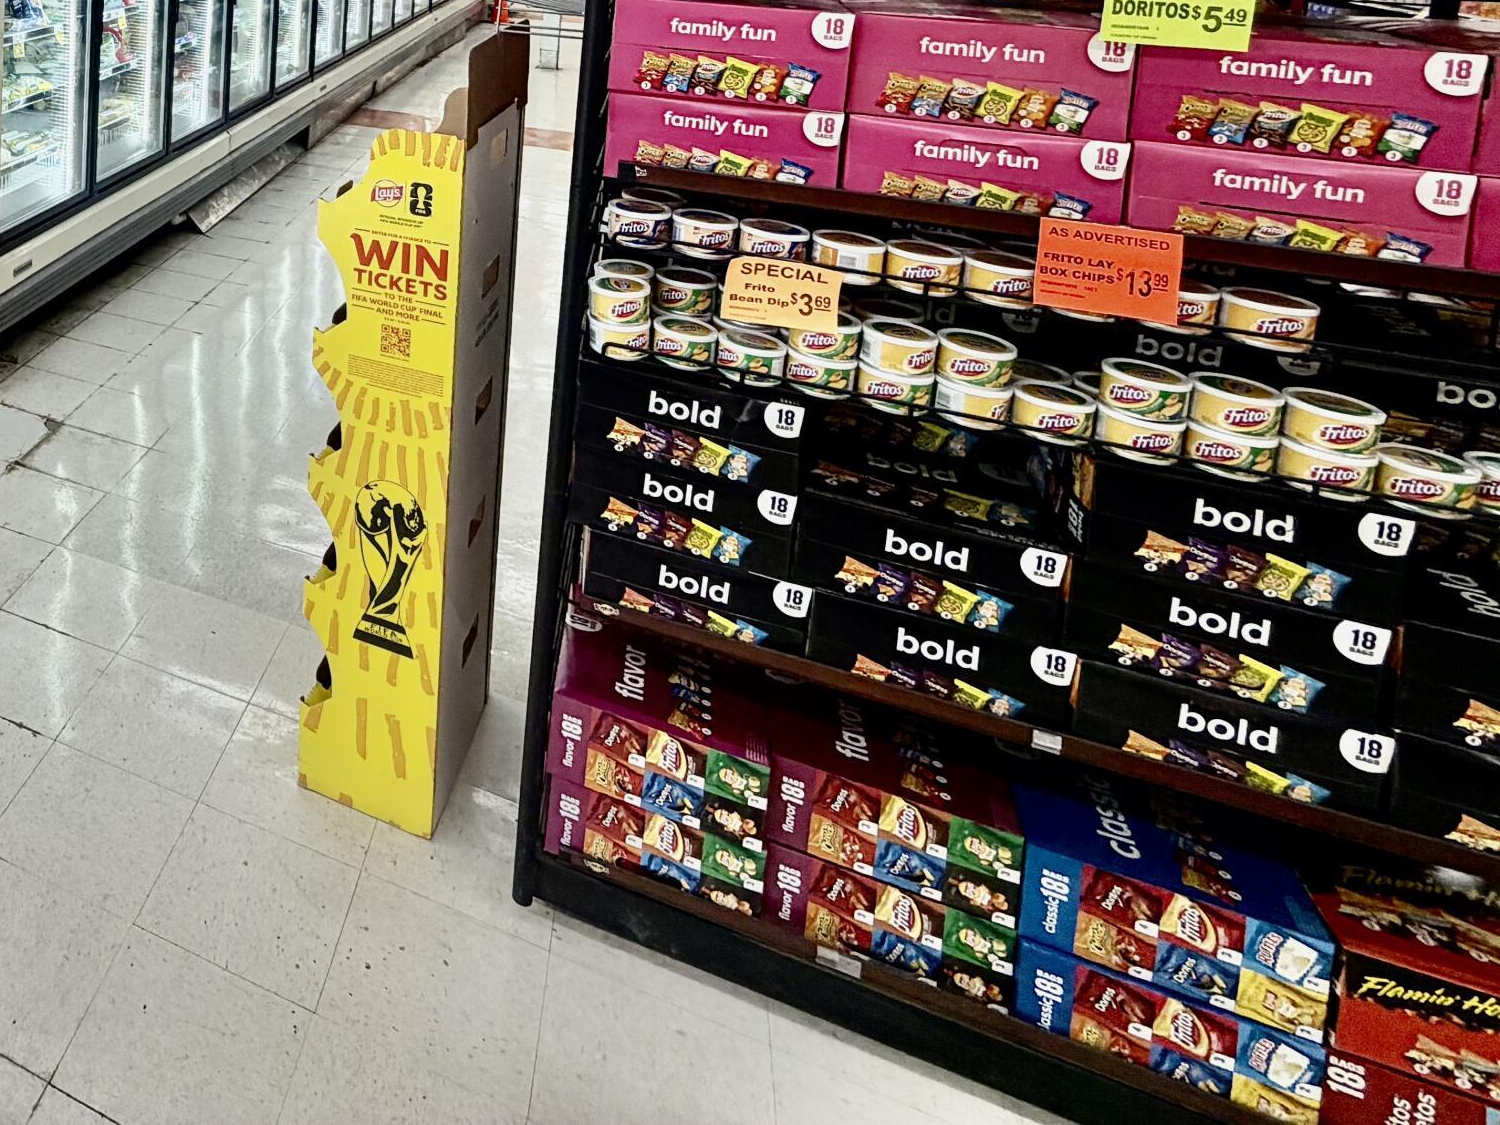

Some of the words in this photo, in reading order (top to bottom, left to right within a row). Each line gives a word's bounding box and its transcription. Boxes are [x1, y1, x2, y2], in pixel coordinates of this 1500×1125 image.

[1111, 0, 1190, 20] DORITOS
[670, 17, 736, 41] family
[740, 21, 777, 43] fun
[824, 18, 845, 36] 18
[919, 36, 998, 62] family
[1002, 42, 1046, 64] fun
[1103, 42, 1127, 57] 18
[1219, 56, 1318, 85] family
[1320, 63, 1374, 87] fun
[1444, 58, 1473, 79] 18
[662, 110, 728, 136] family
[731, 116, 769, 138] fun
[815, 117, 836, 134] 18
[913, 139, 992, 168] family
[996, 146, 1040, 171] fun
[1096, 146, 1119, 166] 18
[375, 185, 401, 202] Lay's
[1212, 168, 1310, 201] family
[1313, 178, 1366, 203] fun
[1434, 178, 1462, 198] 18
[620, 221, 650, 235] Fritos
[1049, 226, 1069, 238] AS
[1073, 230, 1170, 251] ADVERTISED
[350, 232, 449, 283] WIN
[1043, 252, 1084, 266] FRITO
[1087, 258, 1115, 270] LAY
[740, 261, 829, 284] SPECIAL
[904, 265, 941, 279] Fritos
[1039, 265, 1068, 277] BOX
[1072, 270, 1115, 285] CHIPS
[353, 267, 448, 301] TICKETS
[744, 282, 776, 294] Frito
[351, 293, 368, 303] FIFA
[369, 298, 399, 308] WORLD
[400, 303, 417, 313] CUP
[419, 307, 443, 319] FINAL
[384, 292, 396, 300] TO
[398, 294, 413, 304] THE
[729, 293, 763, 306] Bean
[766, 297, 790, 310] Dip
[376, 307, 395, 317] AND
[395, 311, 420, 322] MORE
[802, 332, 837, 348] Fritos
[1135, 332, 1223, 369] bold
[952, 358, 991, 374] Fritos
[648, 390, 722, 430] bold
[777, 409, 796, 425] 18
[643, 473, 715, 513] bold
[1392, 480, 1444, 496] Fritos
[769, 496, 789, 512] 18
[1193, 498, 1295, 544] bold
[1375, 521, 1402, 541] 18
[885, 529, 970, 573] bold
[1035, 556, 1057, 573] 18
[659, 565, 731, 605] bold
[785, 588, 804, 604] 18
[1168, 596, 1272, 647] bold
[896, 627, 980, 671] bold
[1351, 628, 1377, 649] 18
[614, 644, 647, 701] flavor
[1045, 655, 1067, 673] 18
[1177, 703, 1279, 755] bold
[563, 739, 574, 767] flavor
[1357, 737, 1382, 758] 18
[782, 804, 796, 833] flavor
[561, 819, 573, 846] flavor
[778, 891, 793, 921] flavor
[1042, 898, 1059, 933] classic
[1462, 996, 1500, 1018] Ho
